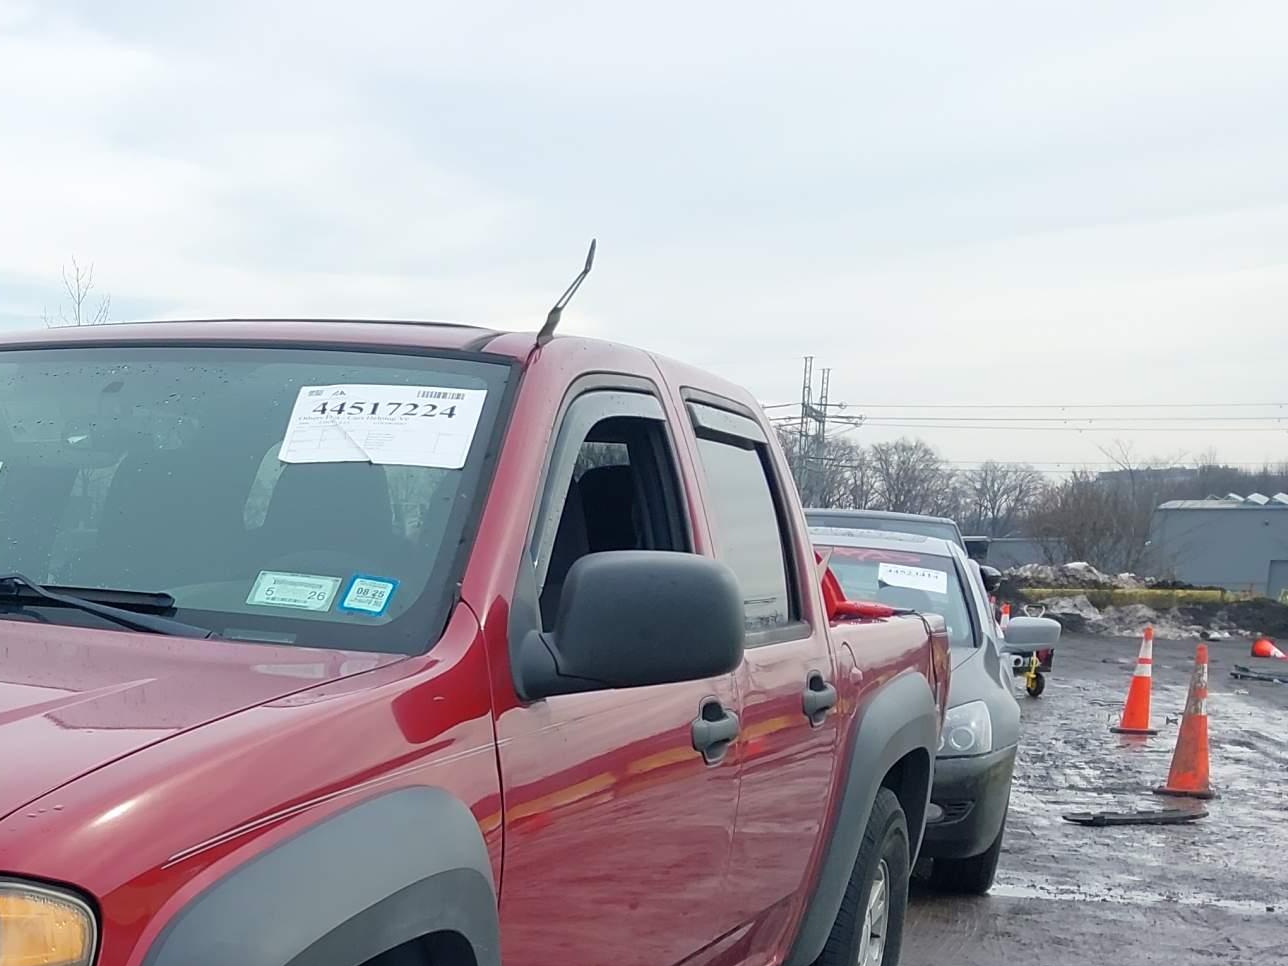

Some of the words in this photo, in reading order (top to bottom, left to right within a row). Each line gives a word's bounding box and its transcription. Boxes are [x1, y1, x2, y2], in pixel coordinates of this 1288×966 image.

[312, 401, 457, 419] 44517224
[265, 586, 276, 597] 5
[307, 590, 327, 601] 26
